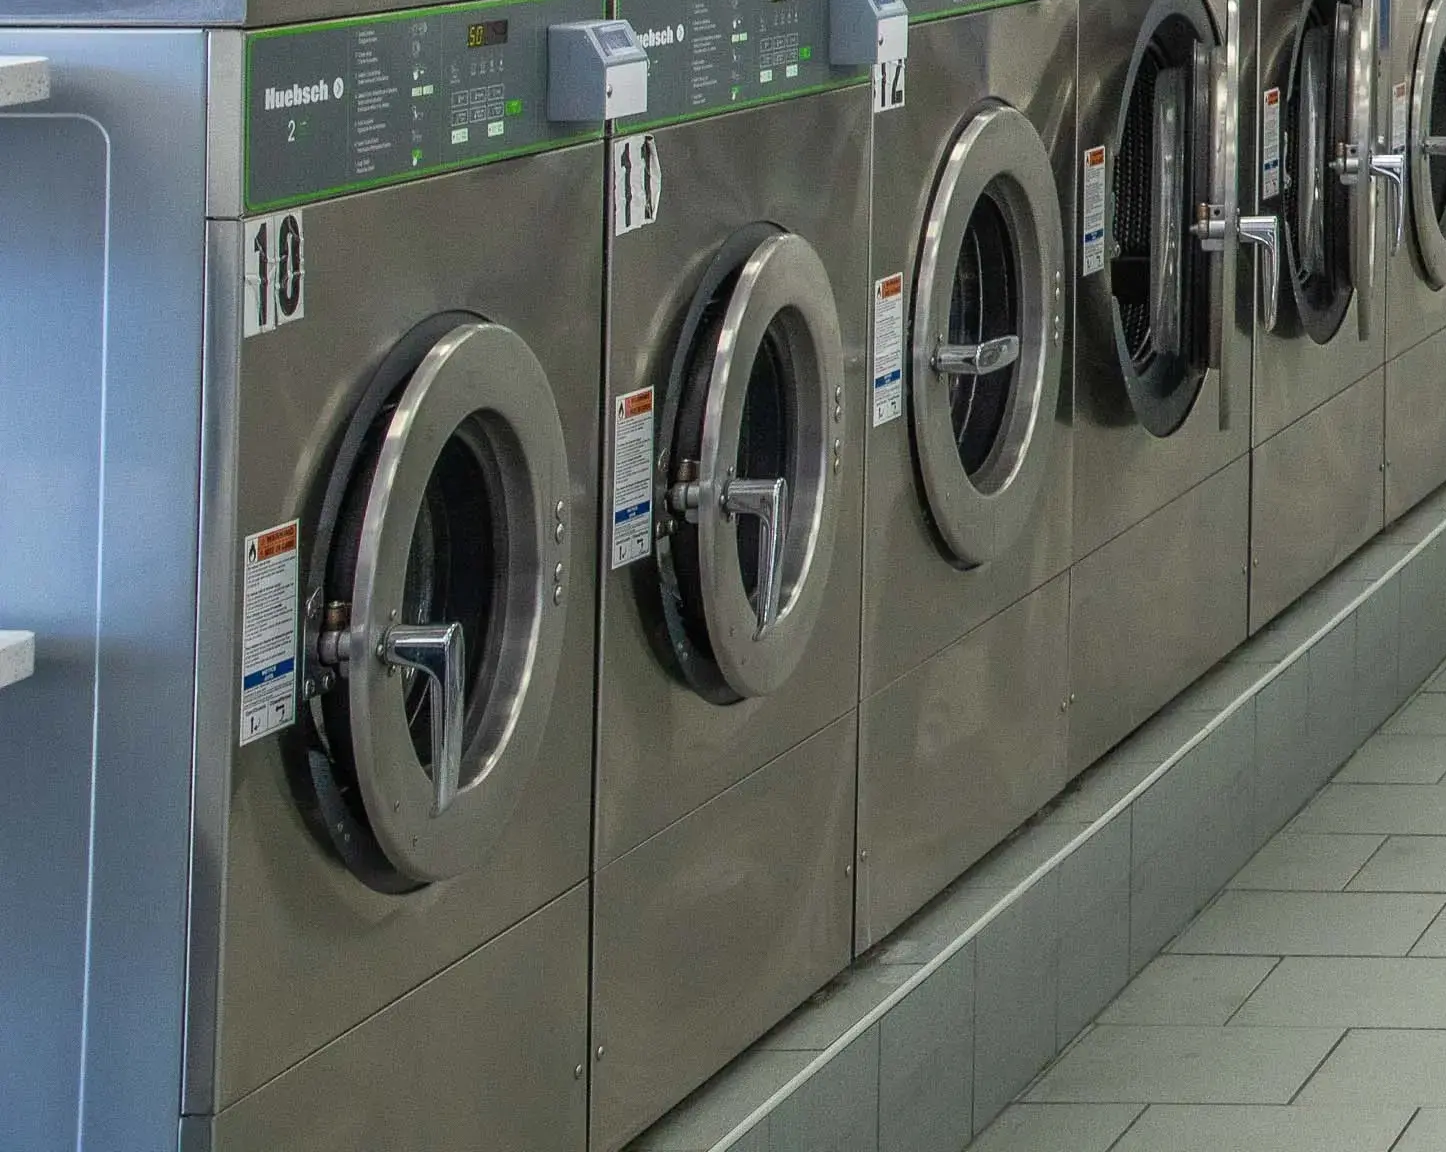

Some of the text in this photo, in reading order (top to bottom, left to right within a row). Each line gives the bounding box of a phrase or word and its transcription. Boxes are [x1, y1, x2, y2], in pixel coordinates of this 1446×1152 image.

[636, 26, 674, 48] uebsch
[264, 79, 329, 111] Huebsch
[620, 137, 654, 228] 11
[254, 214, 301, 325] 10
